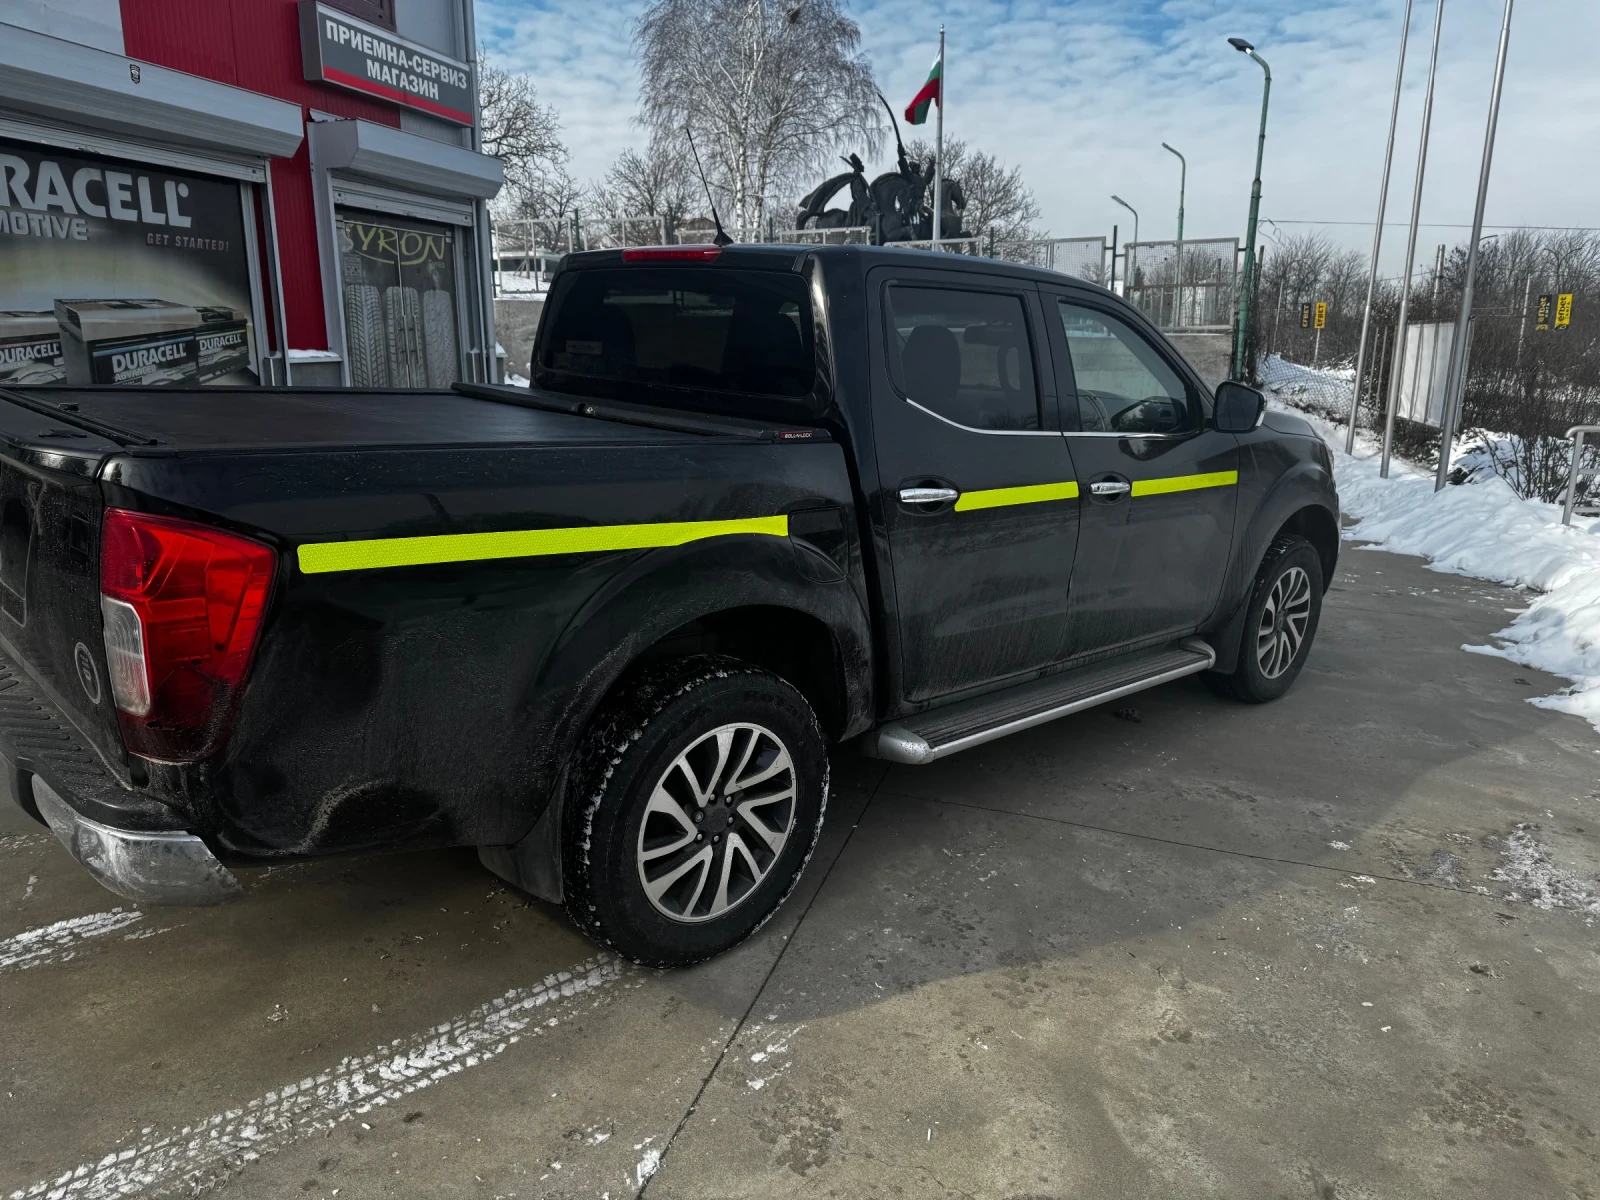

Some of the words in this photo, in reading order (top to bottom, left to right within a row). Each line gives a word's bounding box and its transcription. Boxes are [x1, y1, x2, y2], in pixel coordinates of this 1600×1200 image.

[325, 19, 468, 90] ПРИЕМНА-СЕРВИЗ
[366, 59, 439, 100] МАГАЗИН
[146, 232, 169, 246] GET
[175, 236, 230, 252] STARTED!
[200, 334, 242, 351] DURACELL
[111, 343, 187, 373] DURACELL
